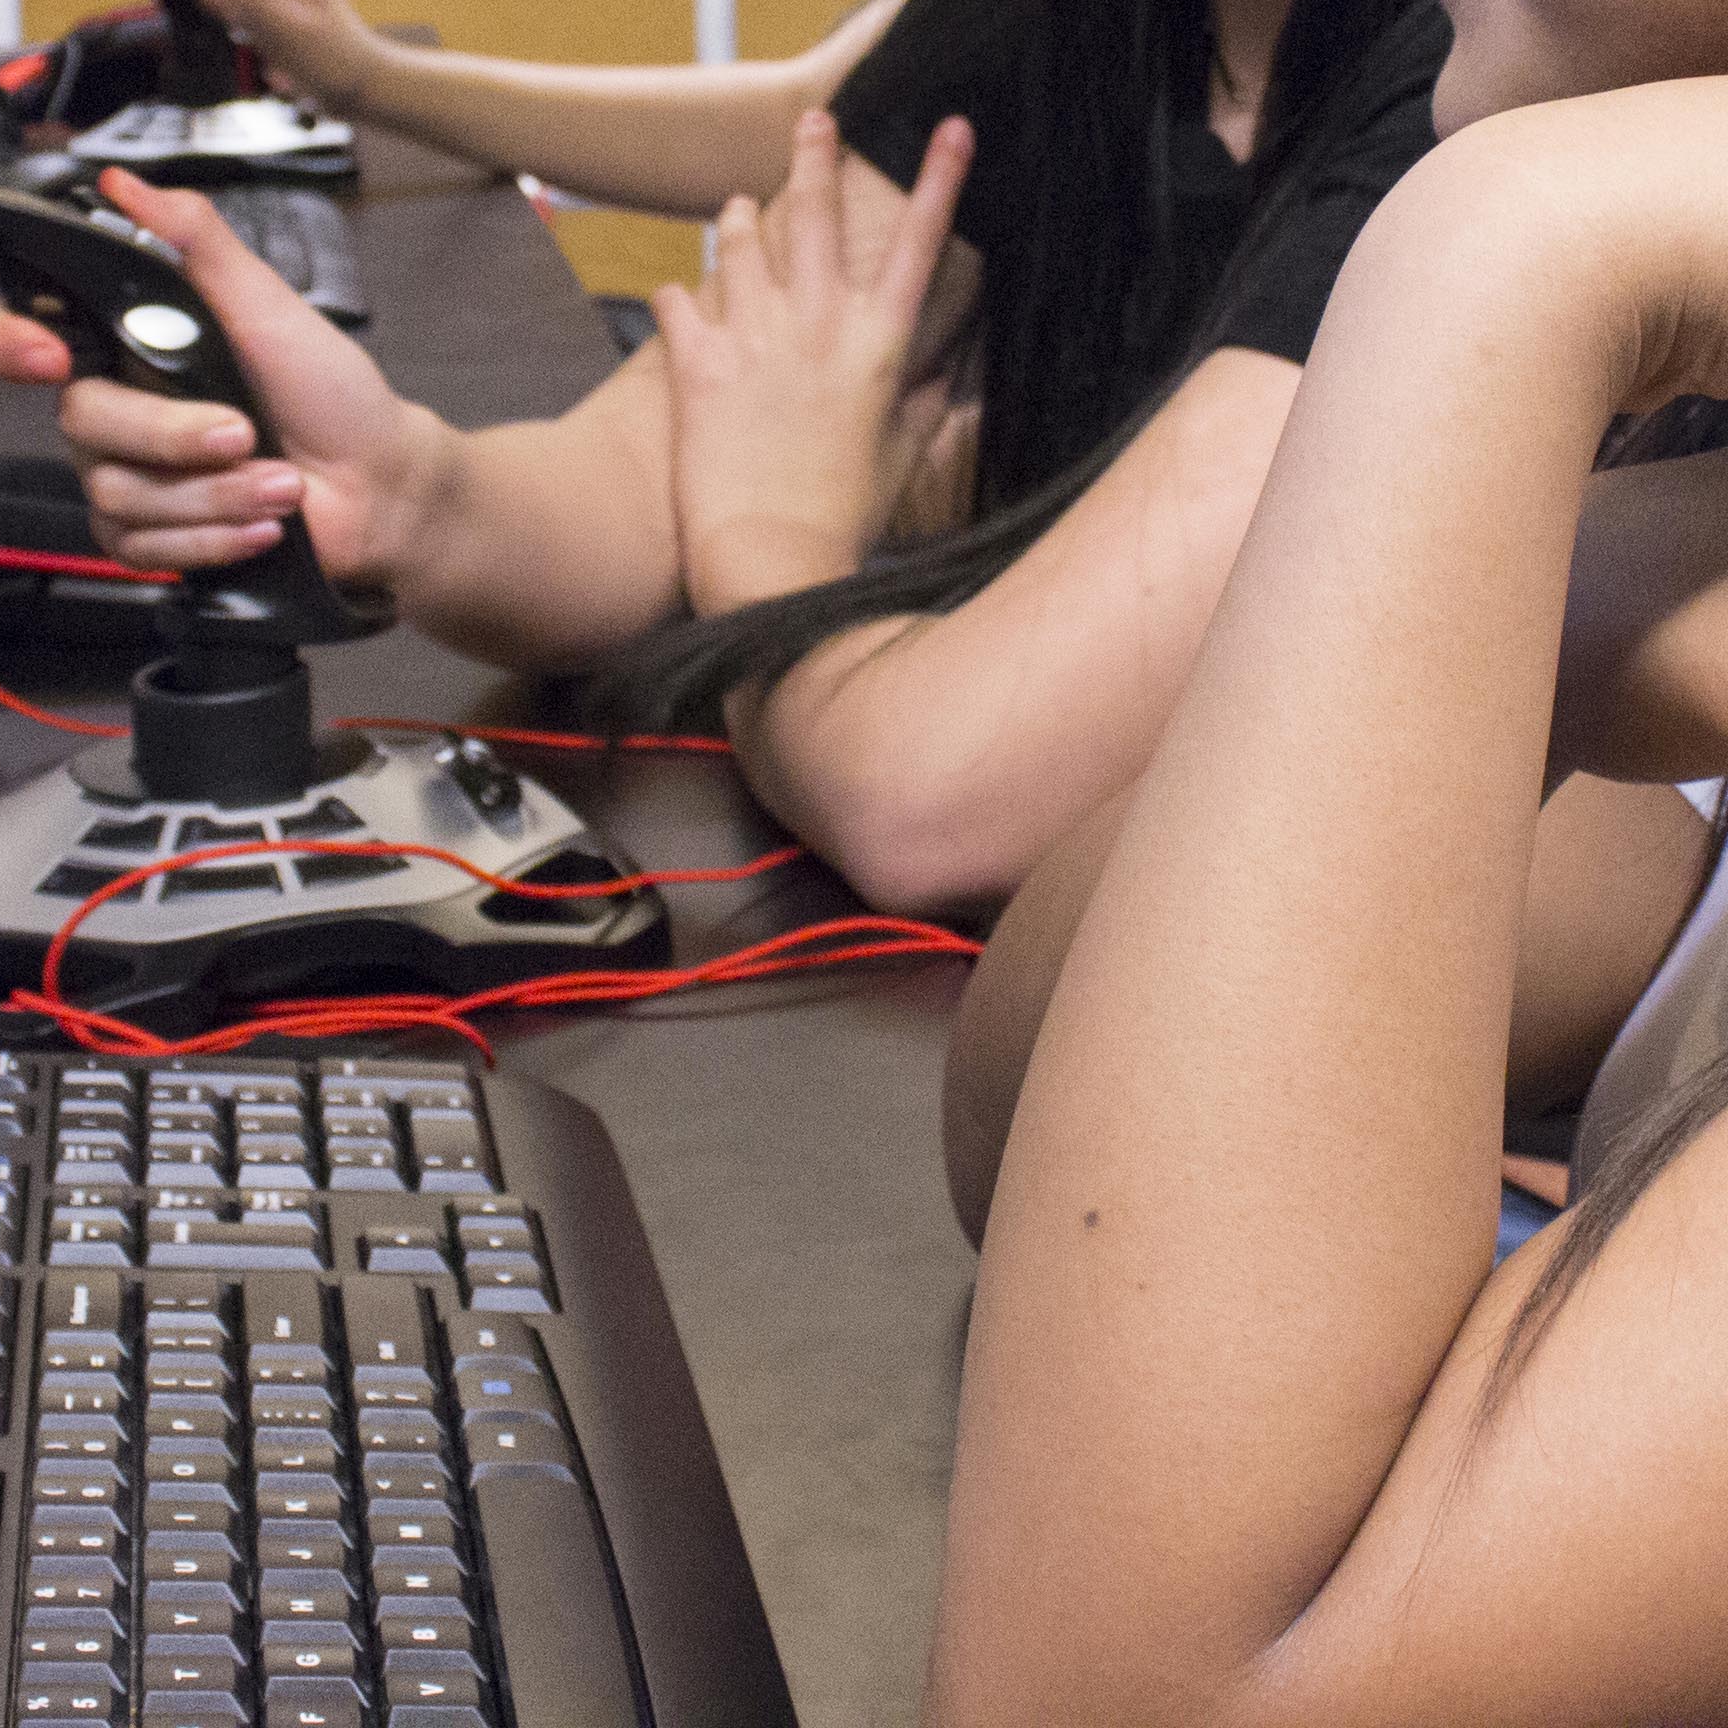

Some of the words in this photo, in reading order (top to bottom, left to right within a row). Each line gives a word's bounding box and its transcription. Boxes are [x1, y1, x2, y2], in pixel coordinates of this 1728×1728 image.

[172, 1419, 194, 1430] P
[282, 1454, 305, 1465] L
[172, 1463, 196, 1476] O
[81, 1486, 106, 1497] 9
[285, 1499, 308, 1511] K
[398, 1525, 423, 1538] M
[79, 1536, 104, 1547] 8
[288, 1549, 313, 1560] J
[173, 1560, 199, 1573] U
[405, 1575, 430, 1588] N
[77, 1587, 101, 1598] 7
[290, 1599, 315, 1612] H
[174, 1613, 199, 1625] Y
[411, 1628, 438, 1640] B
[75, 1641, 101, 1652] 6
[295, 1652, 321, 1667] G
[173, 1668, 200, 1681] T
[419, 1683, 445, 1696] V
[72, 1697, 98, 1709] 5
[299, 1712, 325, 1723] F
